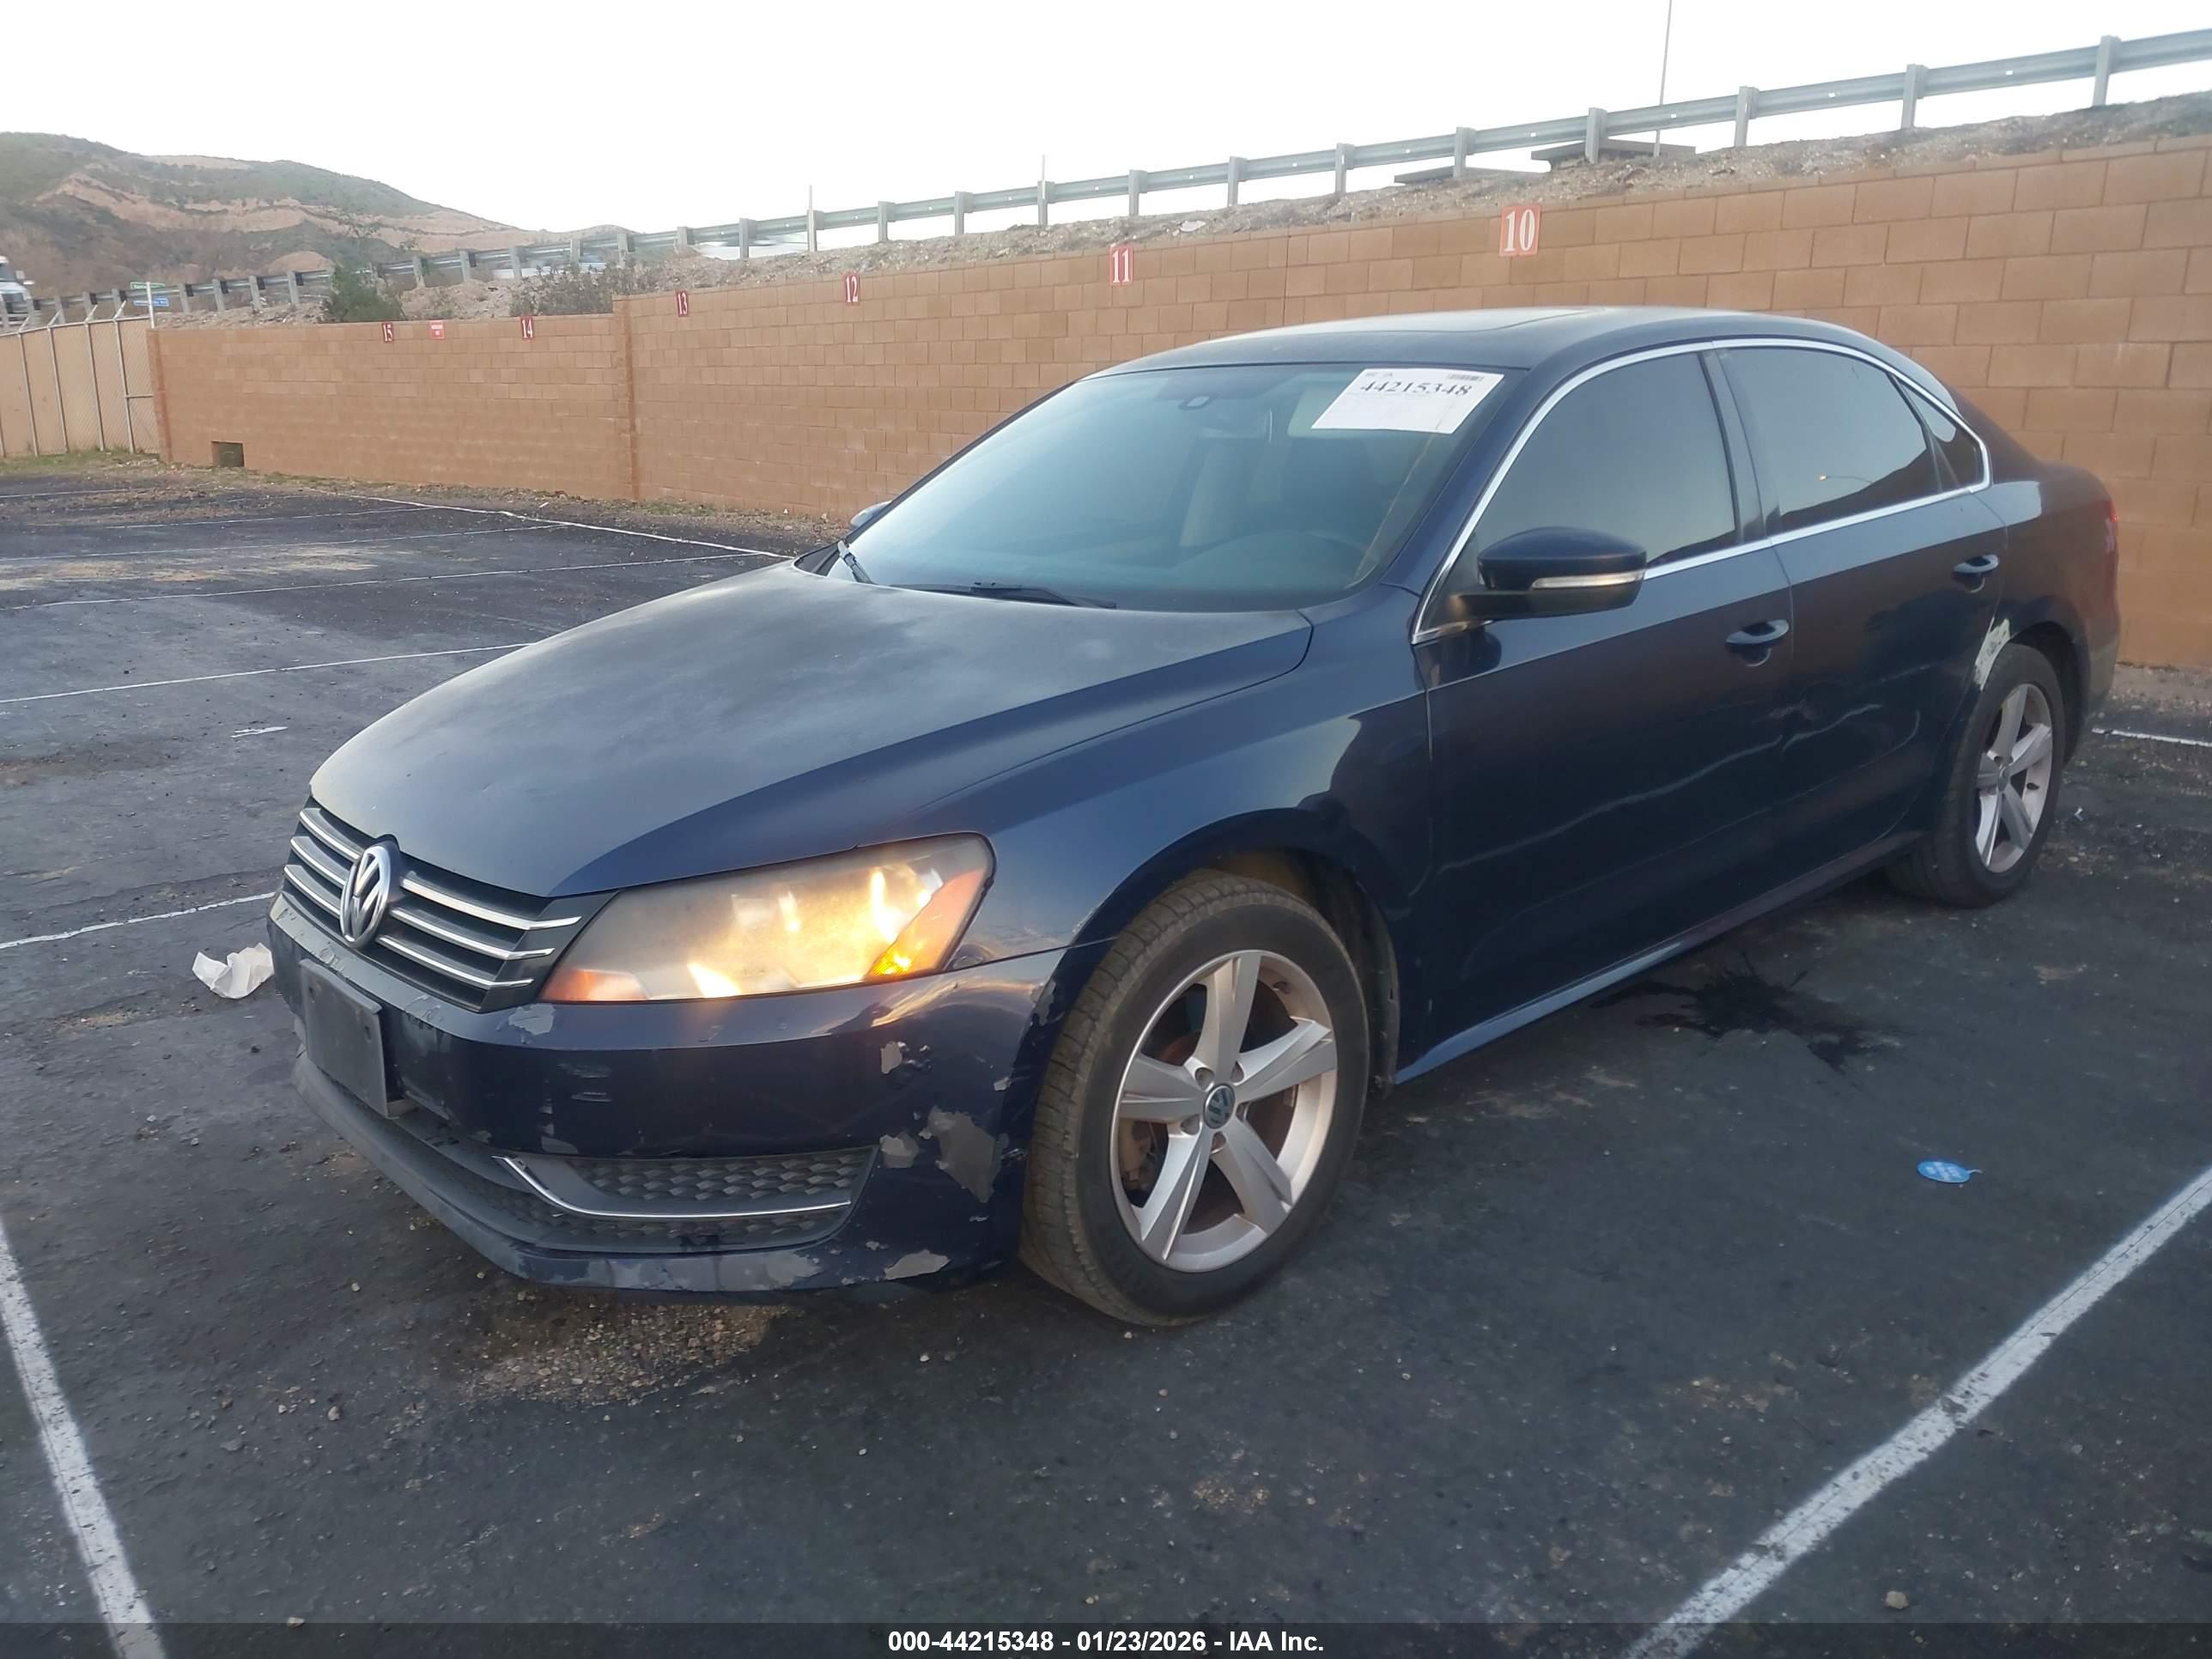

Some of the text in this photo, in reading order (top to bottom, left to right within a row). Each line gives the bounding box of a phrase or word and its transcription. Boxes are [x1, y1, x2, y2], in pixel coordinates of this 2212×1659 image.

[1504, 209, 1535, 252] 10
[1113, 248, 1130, 283] 11
[846, 276, 859, 302] 12
[678, 292, 688, 315] 13
[382, 324, 392, 342] 15
[521, 319, 533, 338] 14
[1360, 380, 1473, 395] 44215348
